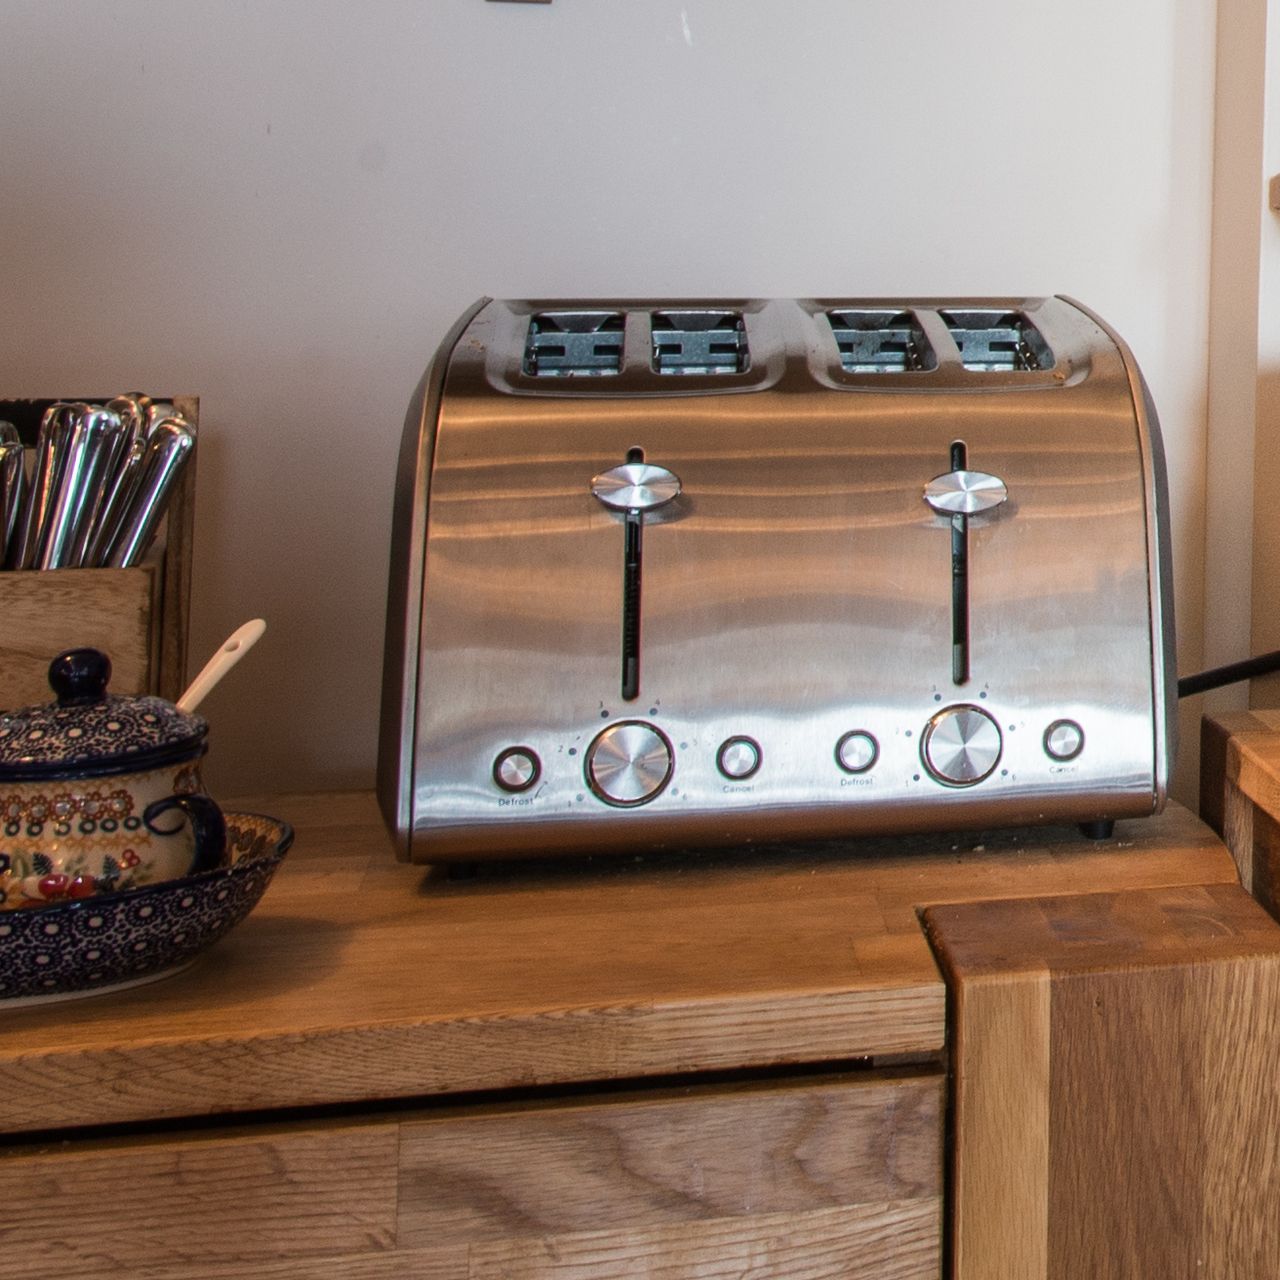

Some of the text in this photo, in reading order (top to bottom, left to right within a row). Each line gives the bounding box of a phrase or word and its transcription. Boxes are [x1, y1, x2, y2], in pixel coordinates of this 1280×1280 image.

[840, 777, 874, 787] Defrost
[722, 784, 755, 794] Cancel
[498, 796, 534, 808] Defrost
